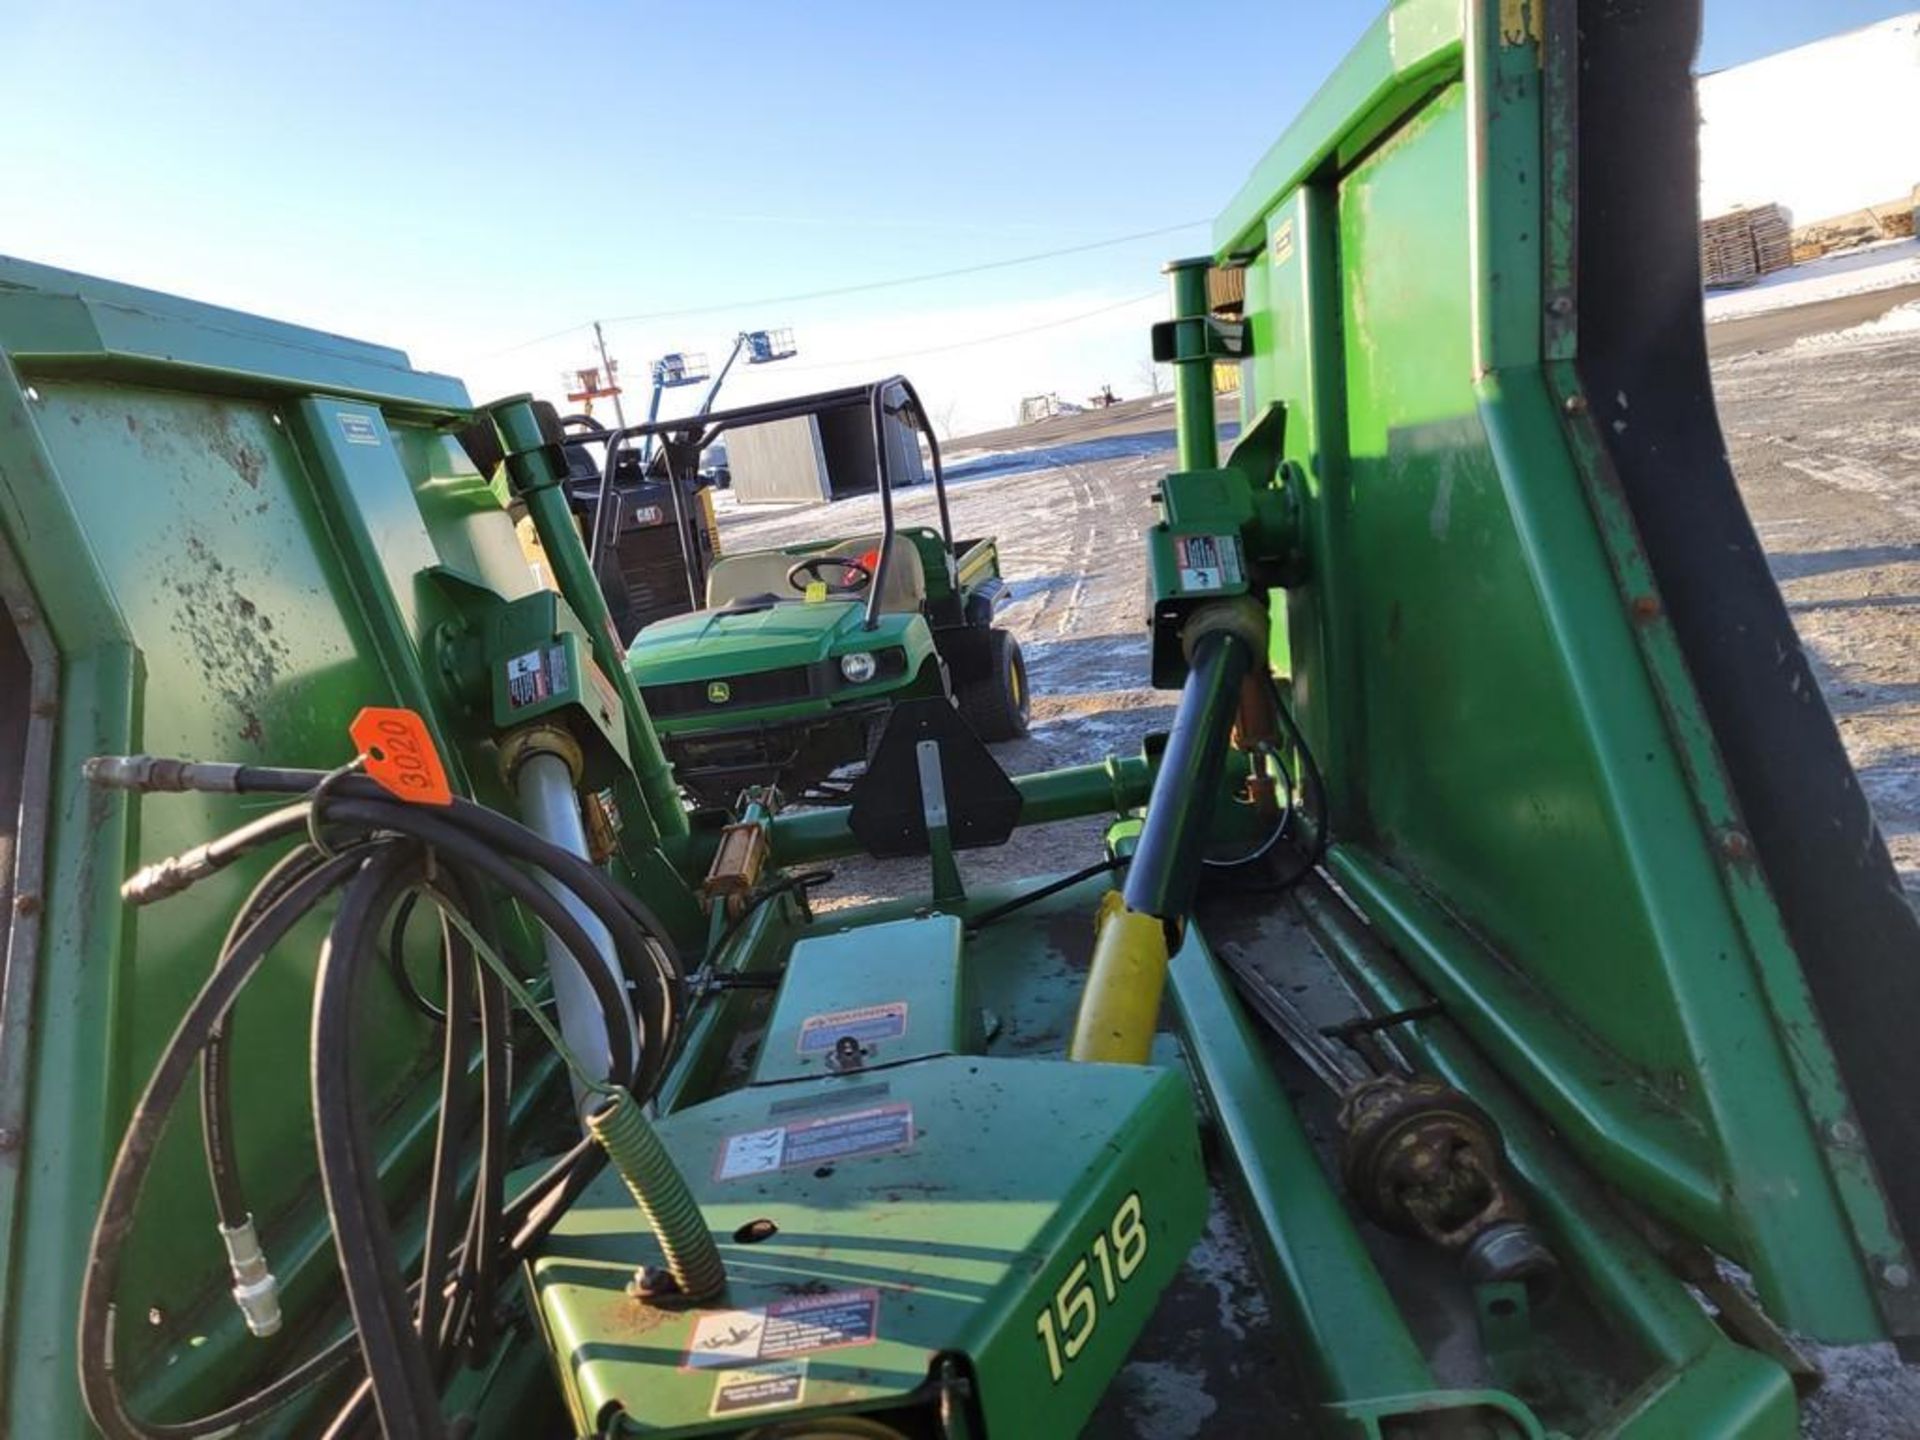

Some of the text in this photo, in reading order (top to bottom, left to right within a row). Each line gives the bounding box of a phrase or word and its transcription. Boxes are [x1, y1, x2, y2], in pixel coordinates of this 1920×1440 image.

[636, 506, 656, 523] CAT
[378, 719, 429, 788] 3020
[1036, 1192, 1148, 1382] 1518
